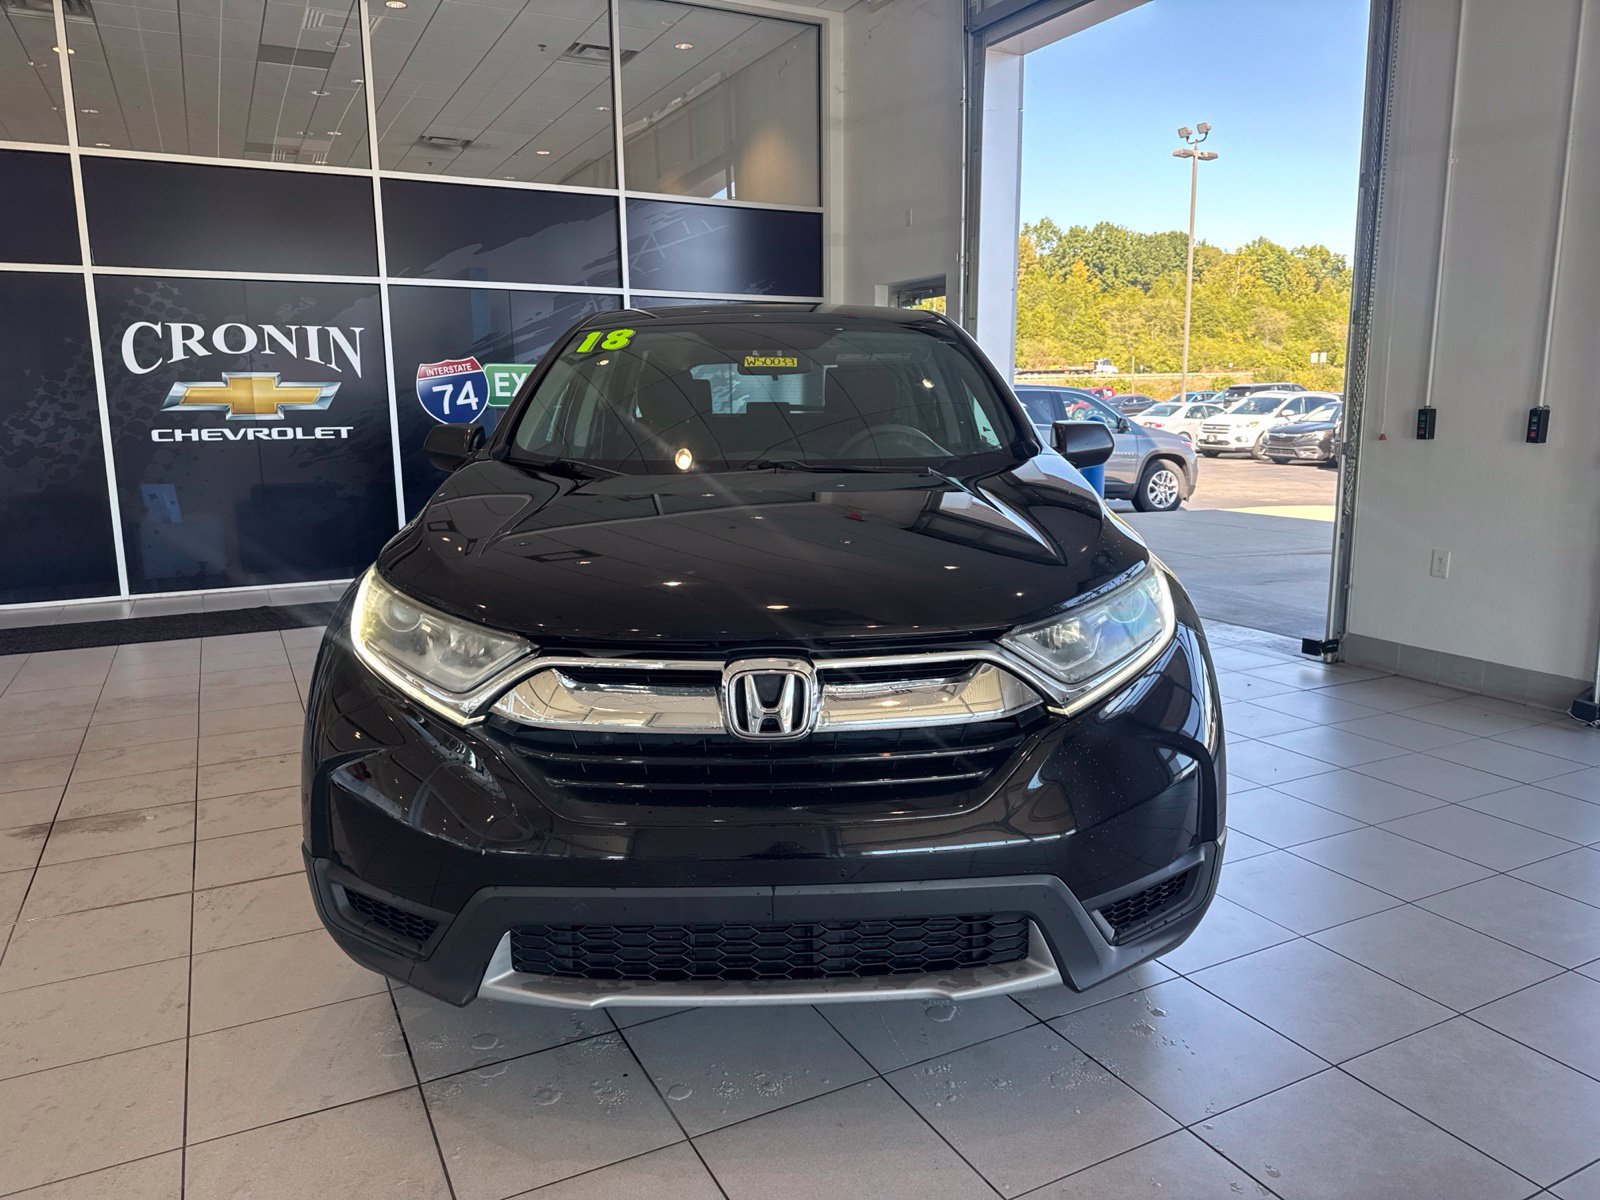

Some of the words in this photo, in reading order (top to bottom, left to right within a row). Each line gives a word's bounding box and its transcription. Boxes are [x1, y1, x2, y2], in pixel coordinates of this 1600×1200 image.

[121, 321, 365, 379] CRONIN
[576, 328, 637, 353] 18
[425, 362, 473, 377] INTERSTATE
[431, 380, 479, 415] 74
[150, 426, 354, 443] CHEVROLET
